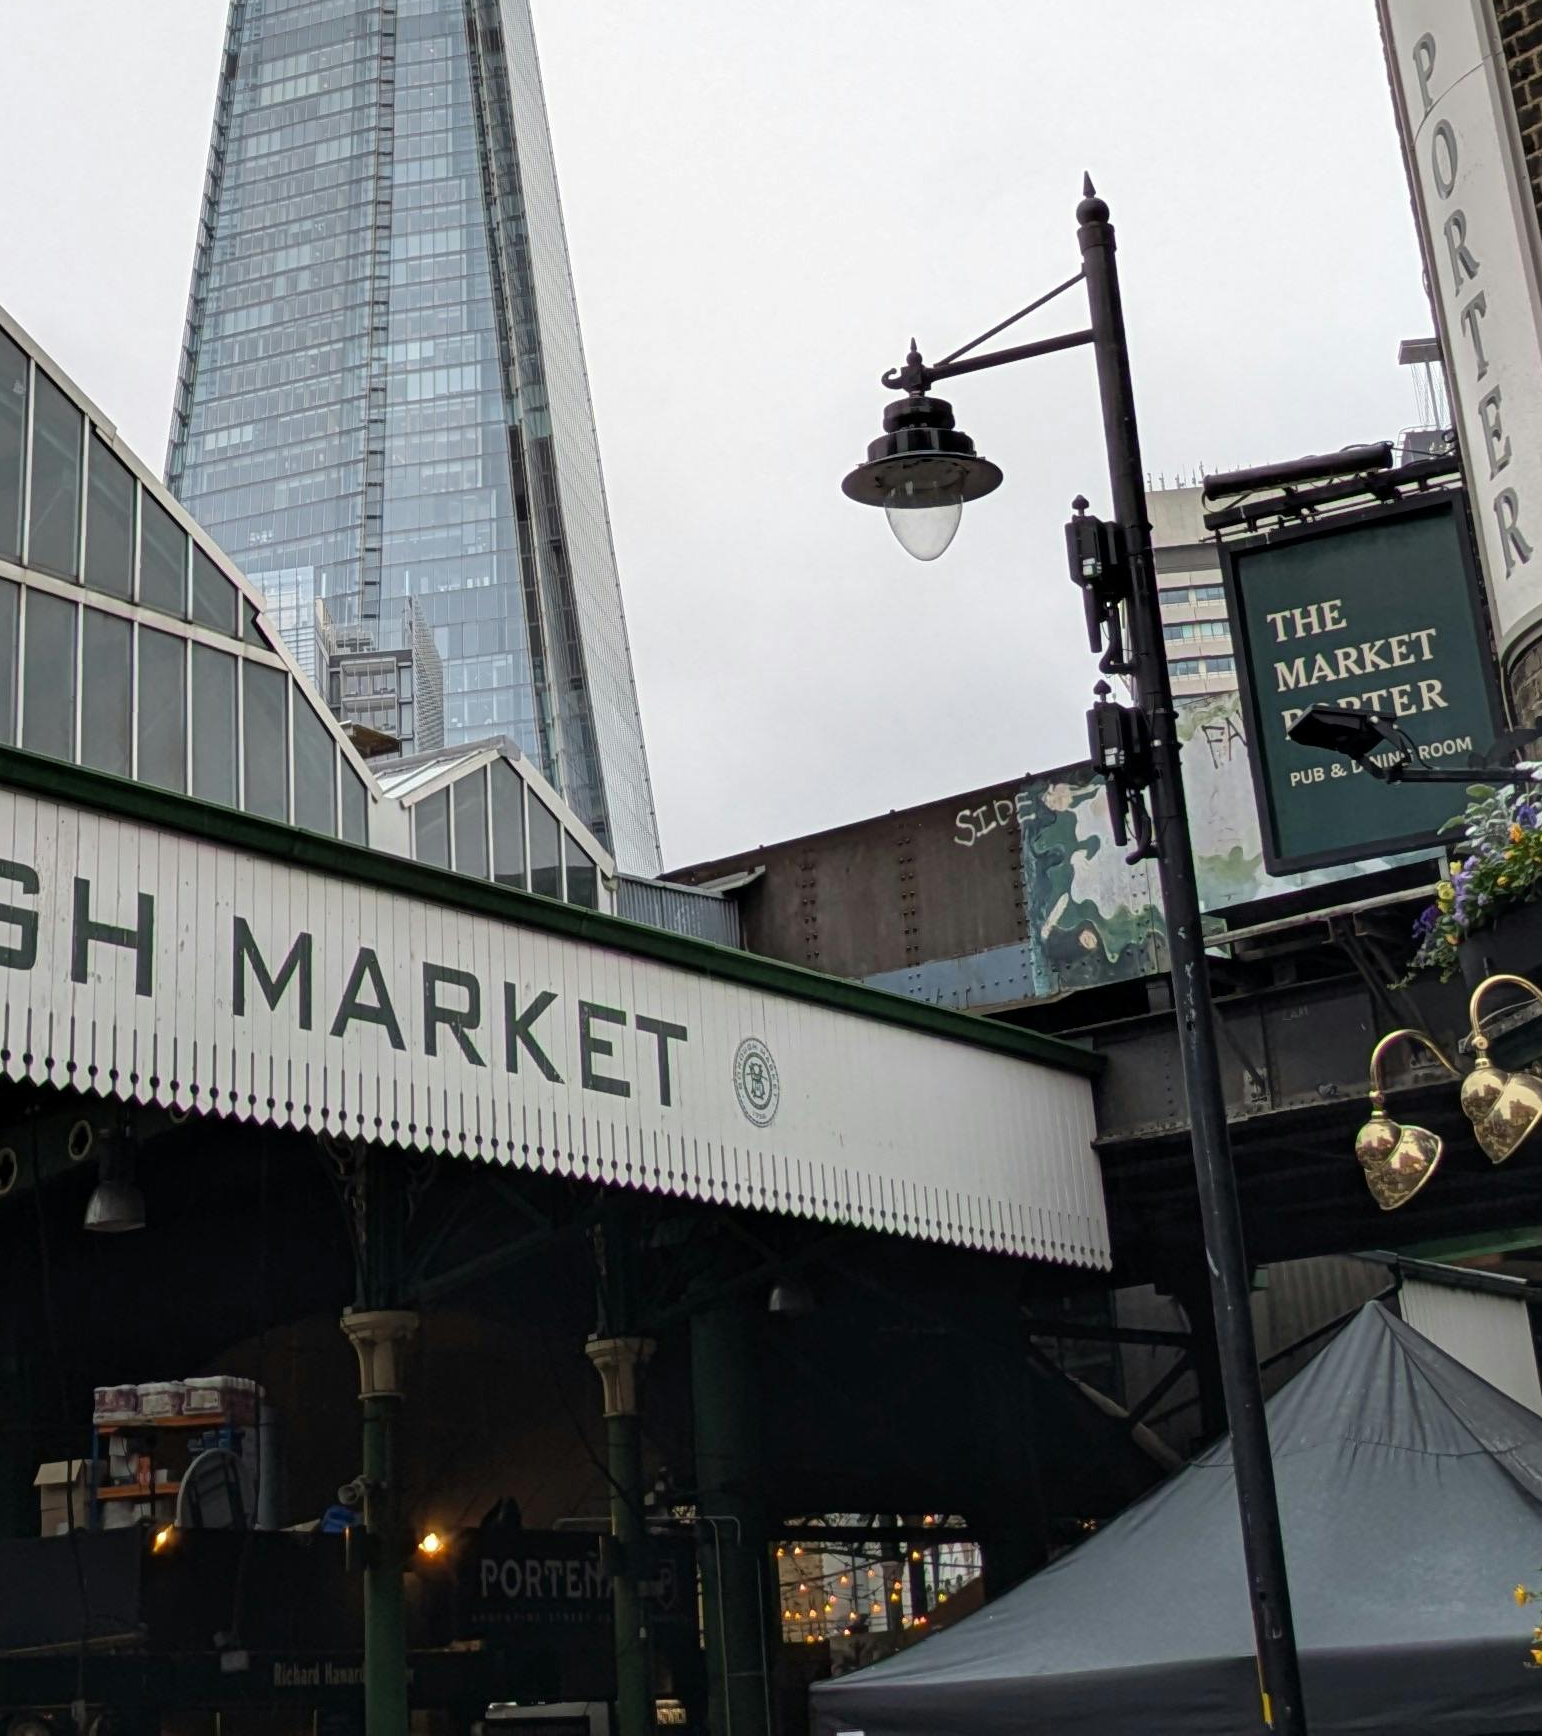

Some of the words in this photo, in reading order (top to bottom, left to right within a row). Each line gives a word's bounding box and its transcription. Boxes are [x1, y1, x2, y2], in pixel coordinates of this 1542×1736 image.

[1412, 32, 1533, 580] PORTER
[1266, 599, 1347, 643] THE
[1273, 628, 1437, 692] MARKET
[1290, 767, 1325, 787] PUB
[1330, 763, 1347, 778] &
[1418, 736, 1473, 761] ROOM
[954, 791, 1036, 847] SIDE
[231, 916, 689, 1107] MARKET
